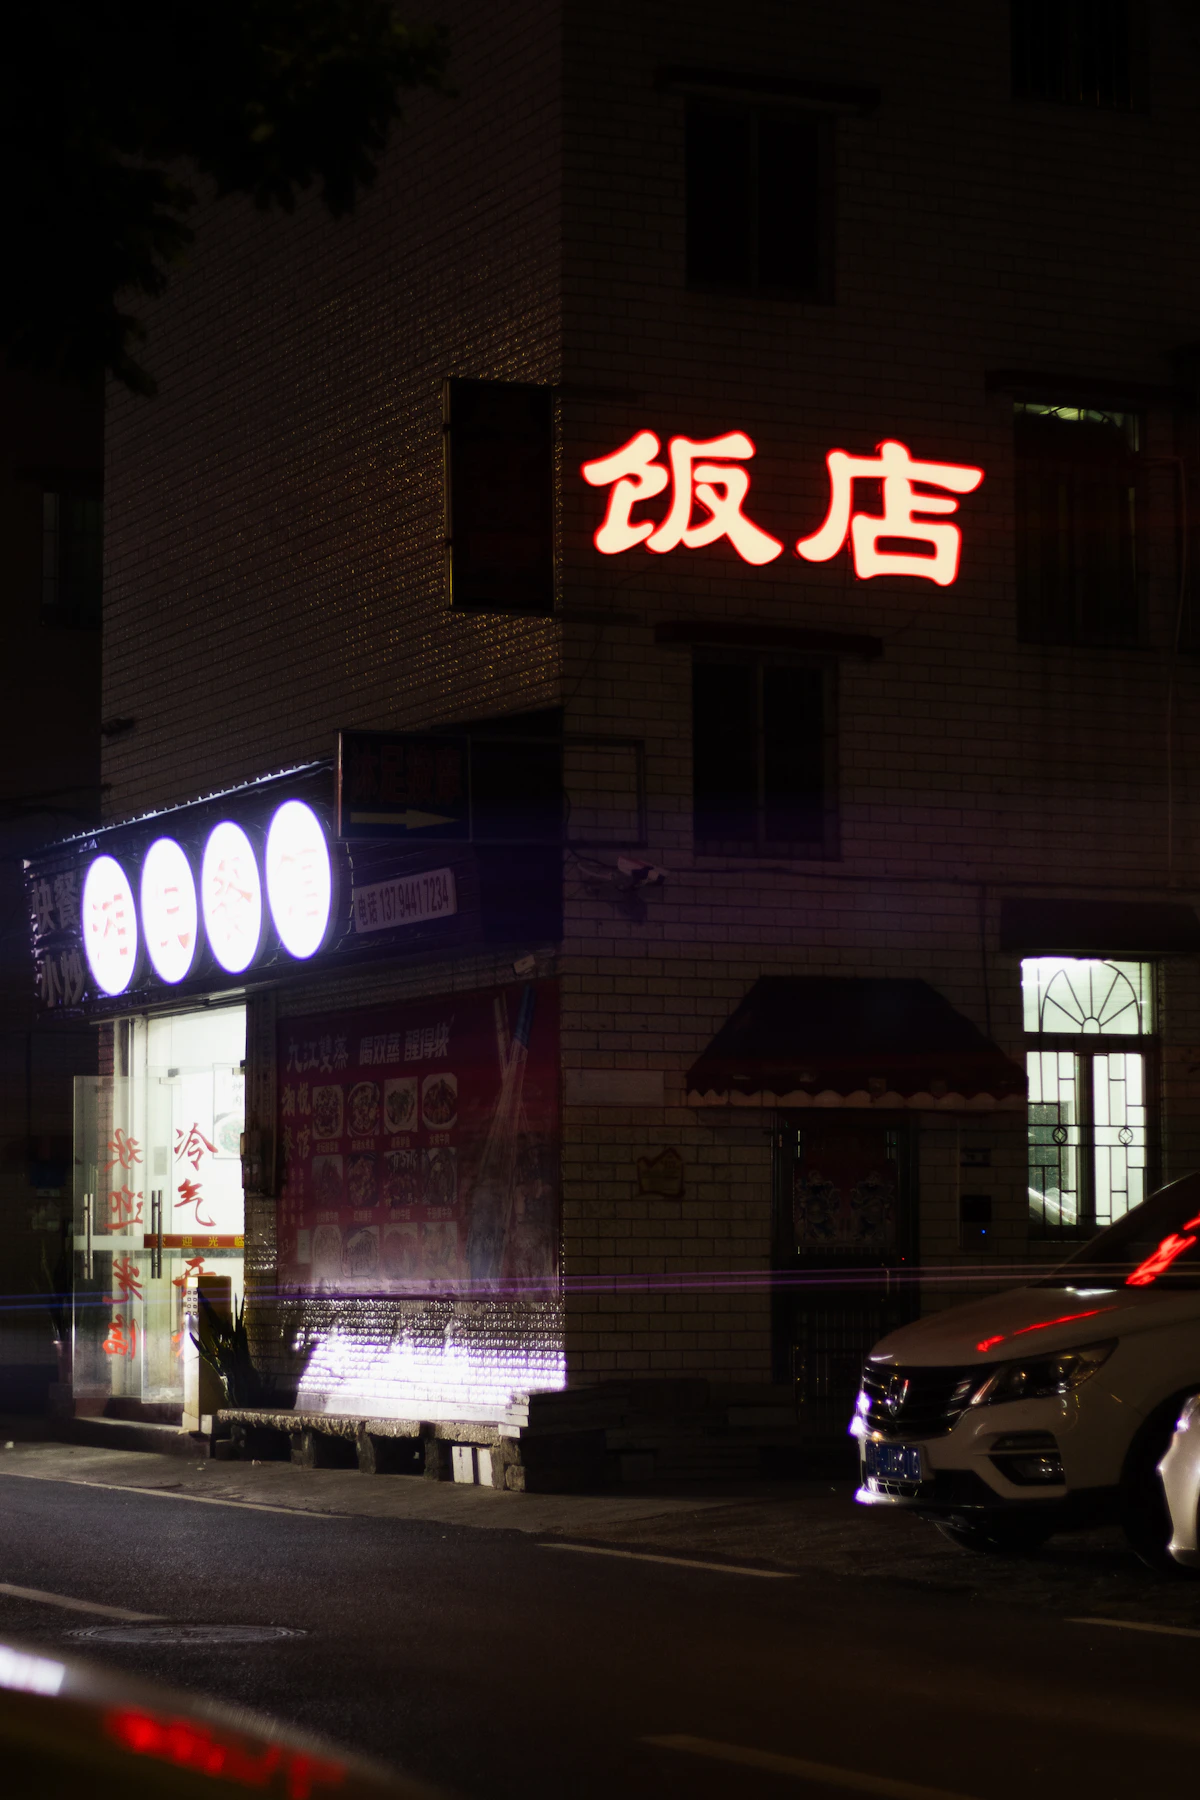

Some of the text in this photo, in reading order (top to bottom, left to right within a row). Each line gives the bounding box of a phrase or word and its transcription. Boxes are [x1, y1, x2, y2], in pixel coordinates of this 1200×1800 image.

[582, 429, 985, 586] 饭店
[31, 871, 79, 934] 快餐
[358, 890, 378, 927] 电话
[40, 948, 86, 1008] 小炒
